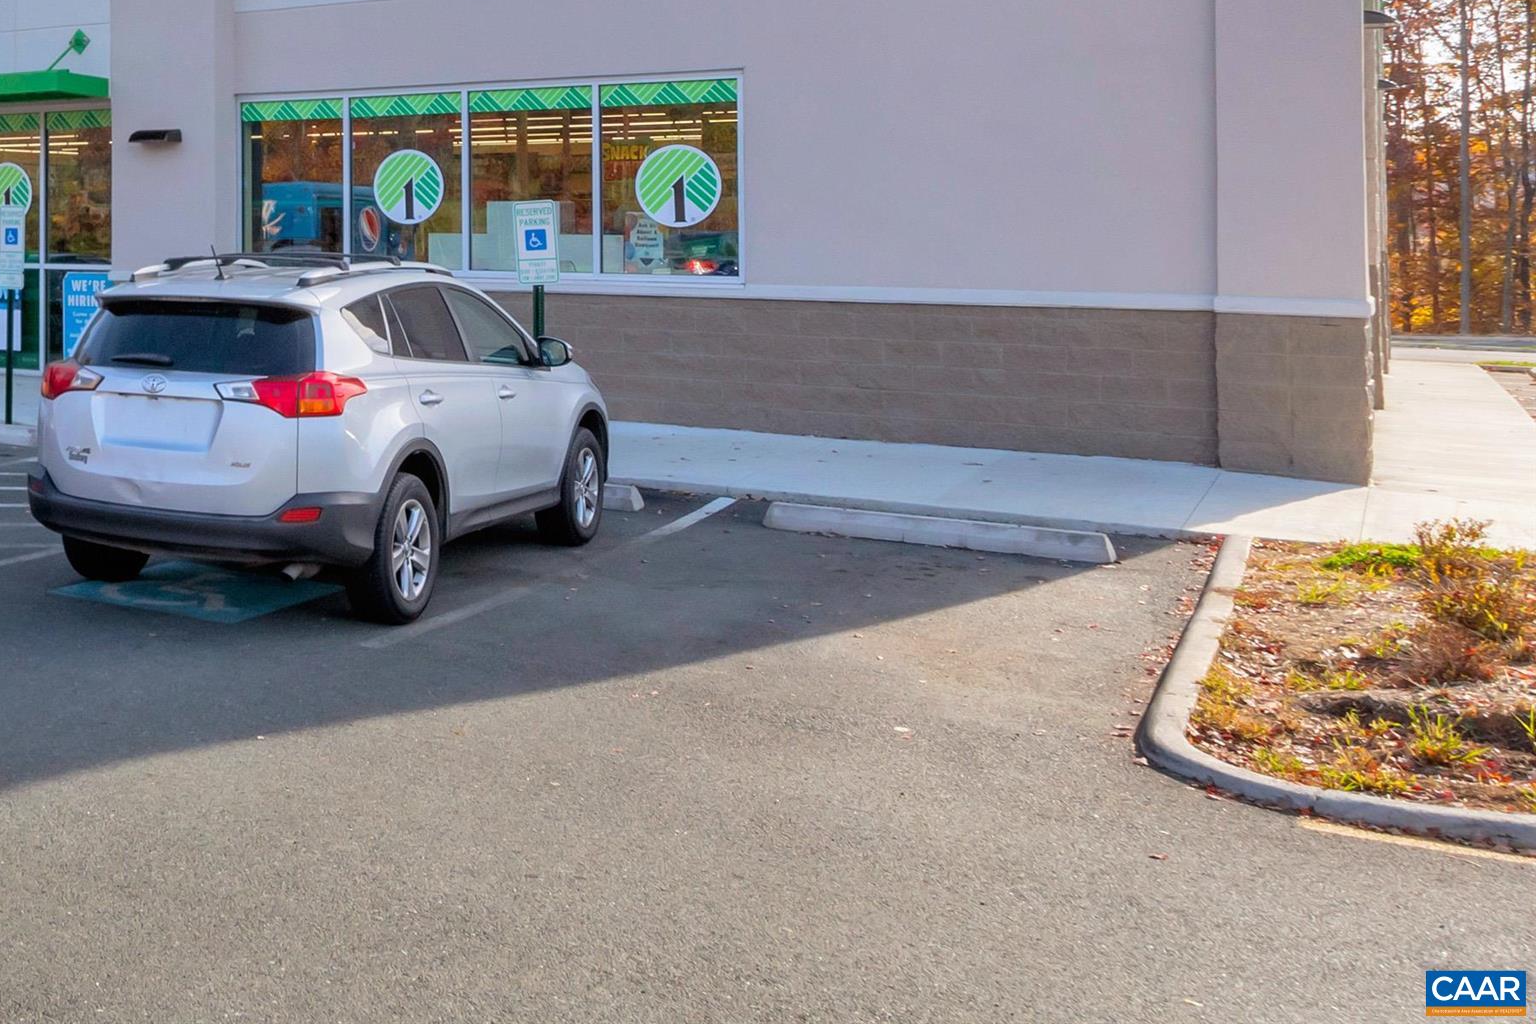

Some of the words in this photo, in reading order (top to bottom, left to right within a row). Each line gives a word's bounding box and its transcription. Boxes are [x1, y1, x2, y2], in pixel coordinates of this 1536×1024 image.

[517, 207, 552, 217] RESERVED
[519, 217, 551, 226] PARKING
[71, 279, 106, 292] WE'RE
[67, 294, 99, 307] HIRIN
